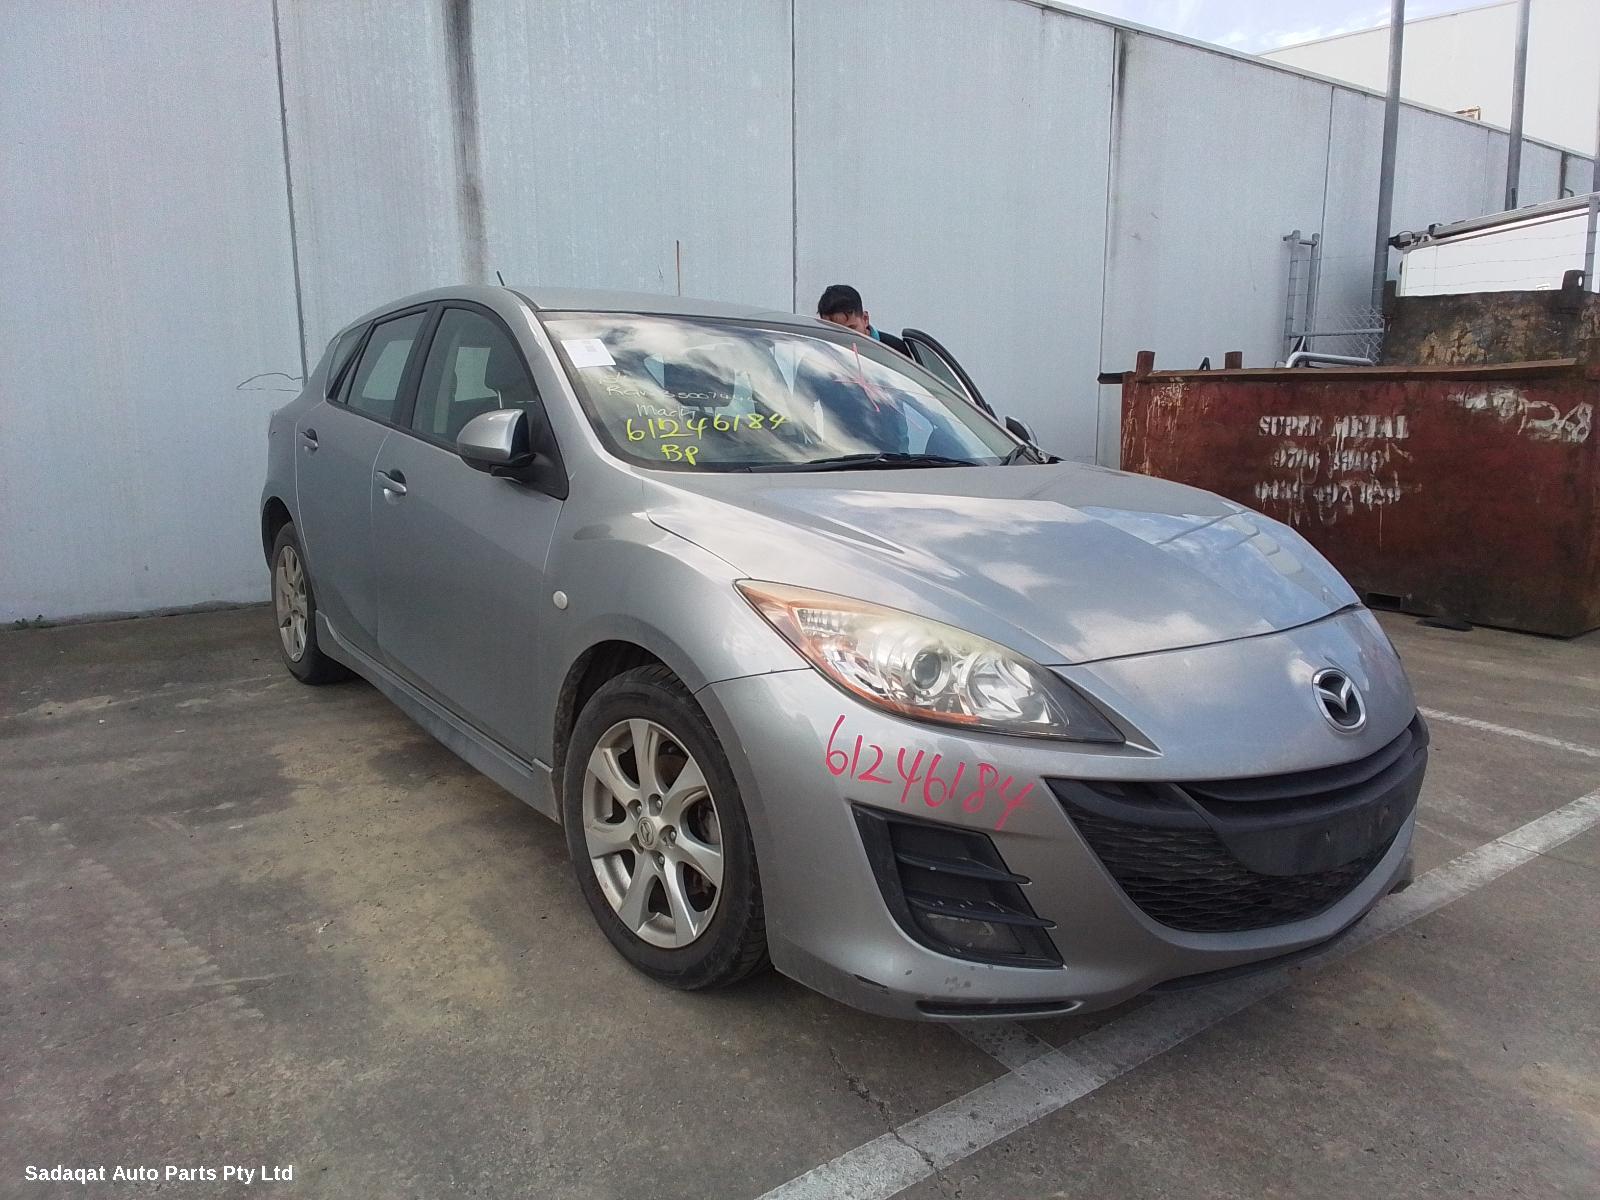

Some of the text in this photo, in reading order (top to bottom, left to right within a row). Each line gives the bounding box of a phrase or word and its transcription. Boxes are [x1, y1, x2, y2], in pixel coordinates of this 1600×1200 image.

[627, 413, 788, 442] 61246184
[1331, 416, 1411, 439] METAL
[825, 714, 1035, 831] 61246184
